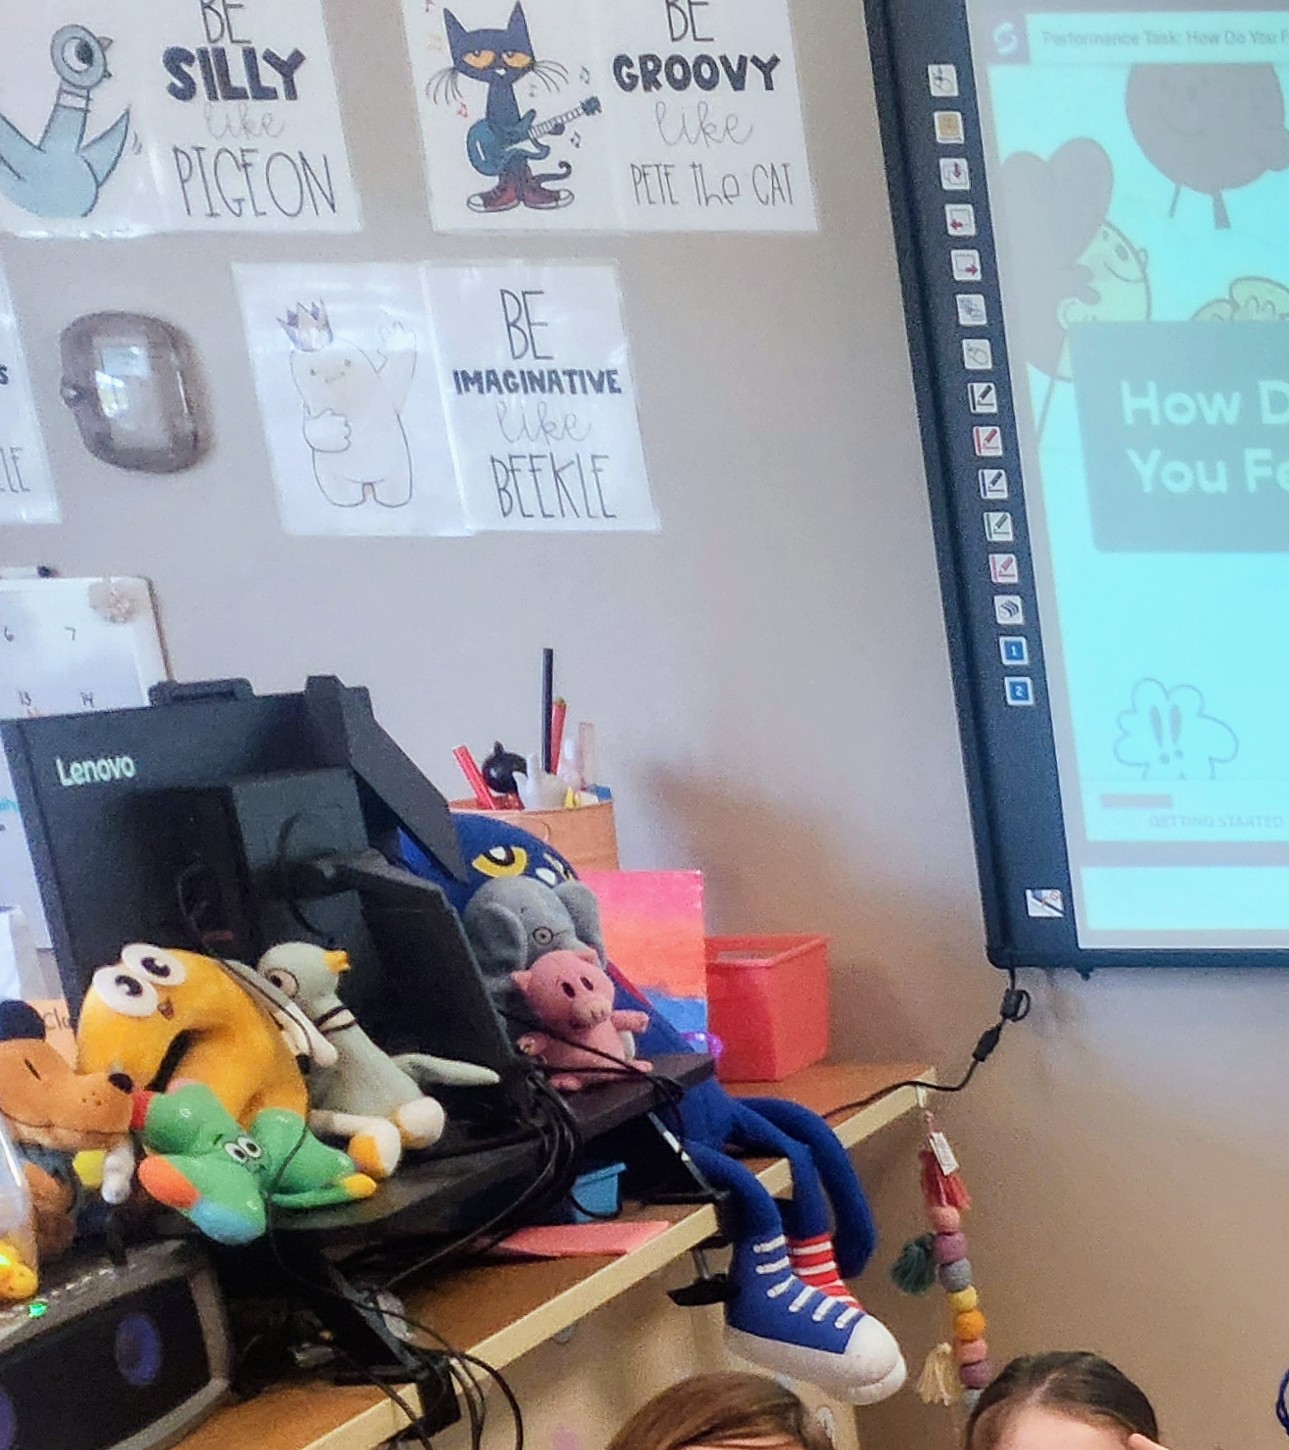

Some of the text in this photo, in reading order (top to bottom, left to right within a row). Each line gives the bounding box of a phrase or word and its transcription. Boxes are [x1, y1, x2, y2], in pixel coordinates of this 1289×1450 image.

[200, 0, 251, 43] BE
[666, 0, 714, 42] BE
[1042, 29, 1140, 47] Performance
[1187, 29, 1221, 46] How
[1225, 29, 1246, 46] Do
[1249, 29, 1276, 46] You
[163, 46, 306, 101] SILLY
[612, 53, 781, 92] GROOVY
[205, 103, 286, 139] like
[655, 101, 753, 147] like
[173, 145, 337, 217] PIGEON
[630, 162, 678, 205] PETE
[751, 162, 794, 206] CAT
[500, 288, 554, 360] BE
[453, 368, 622, 395] IMAGINATIVE
[1120, 379, 1242, 426] How
[496, 401, 592, 445] like
[490, 452, 617, 518] BEEKLE
[1126, 448, 1228, 493] You
[57, 755, 136, 786] Lenovo
[1150, 815, 1284, 829] GETTING STARTED
